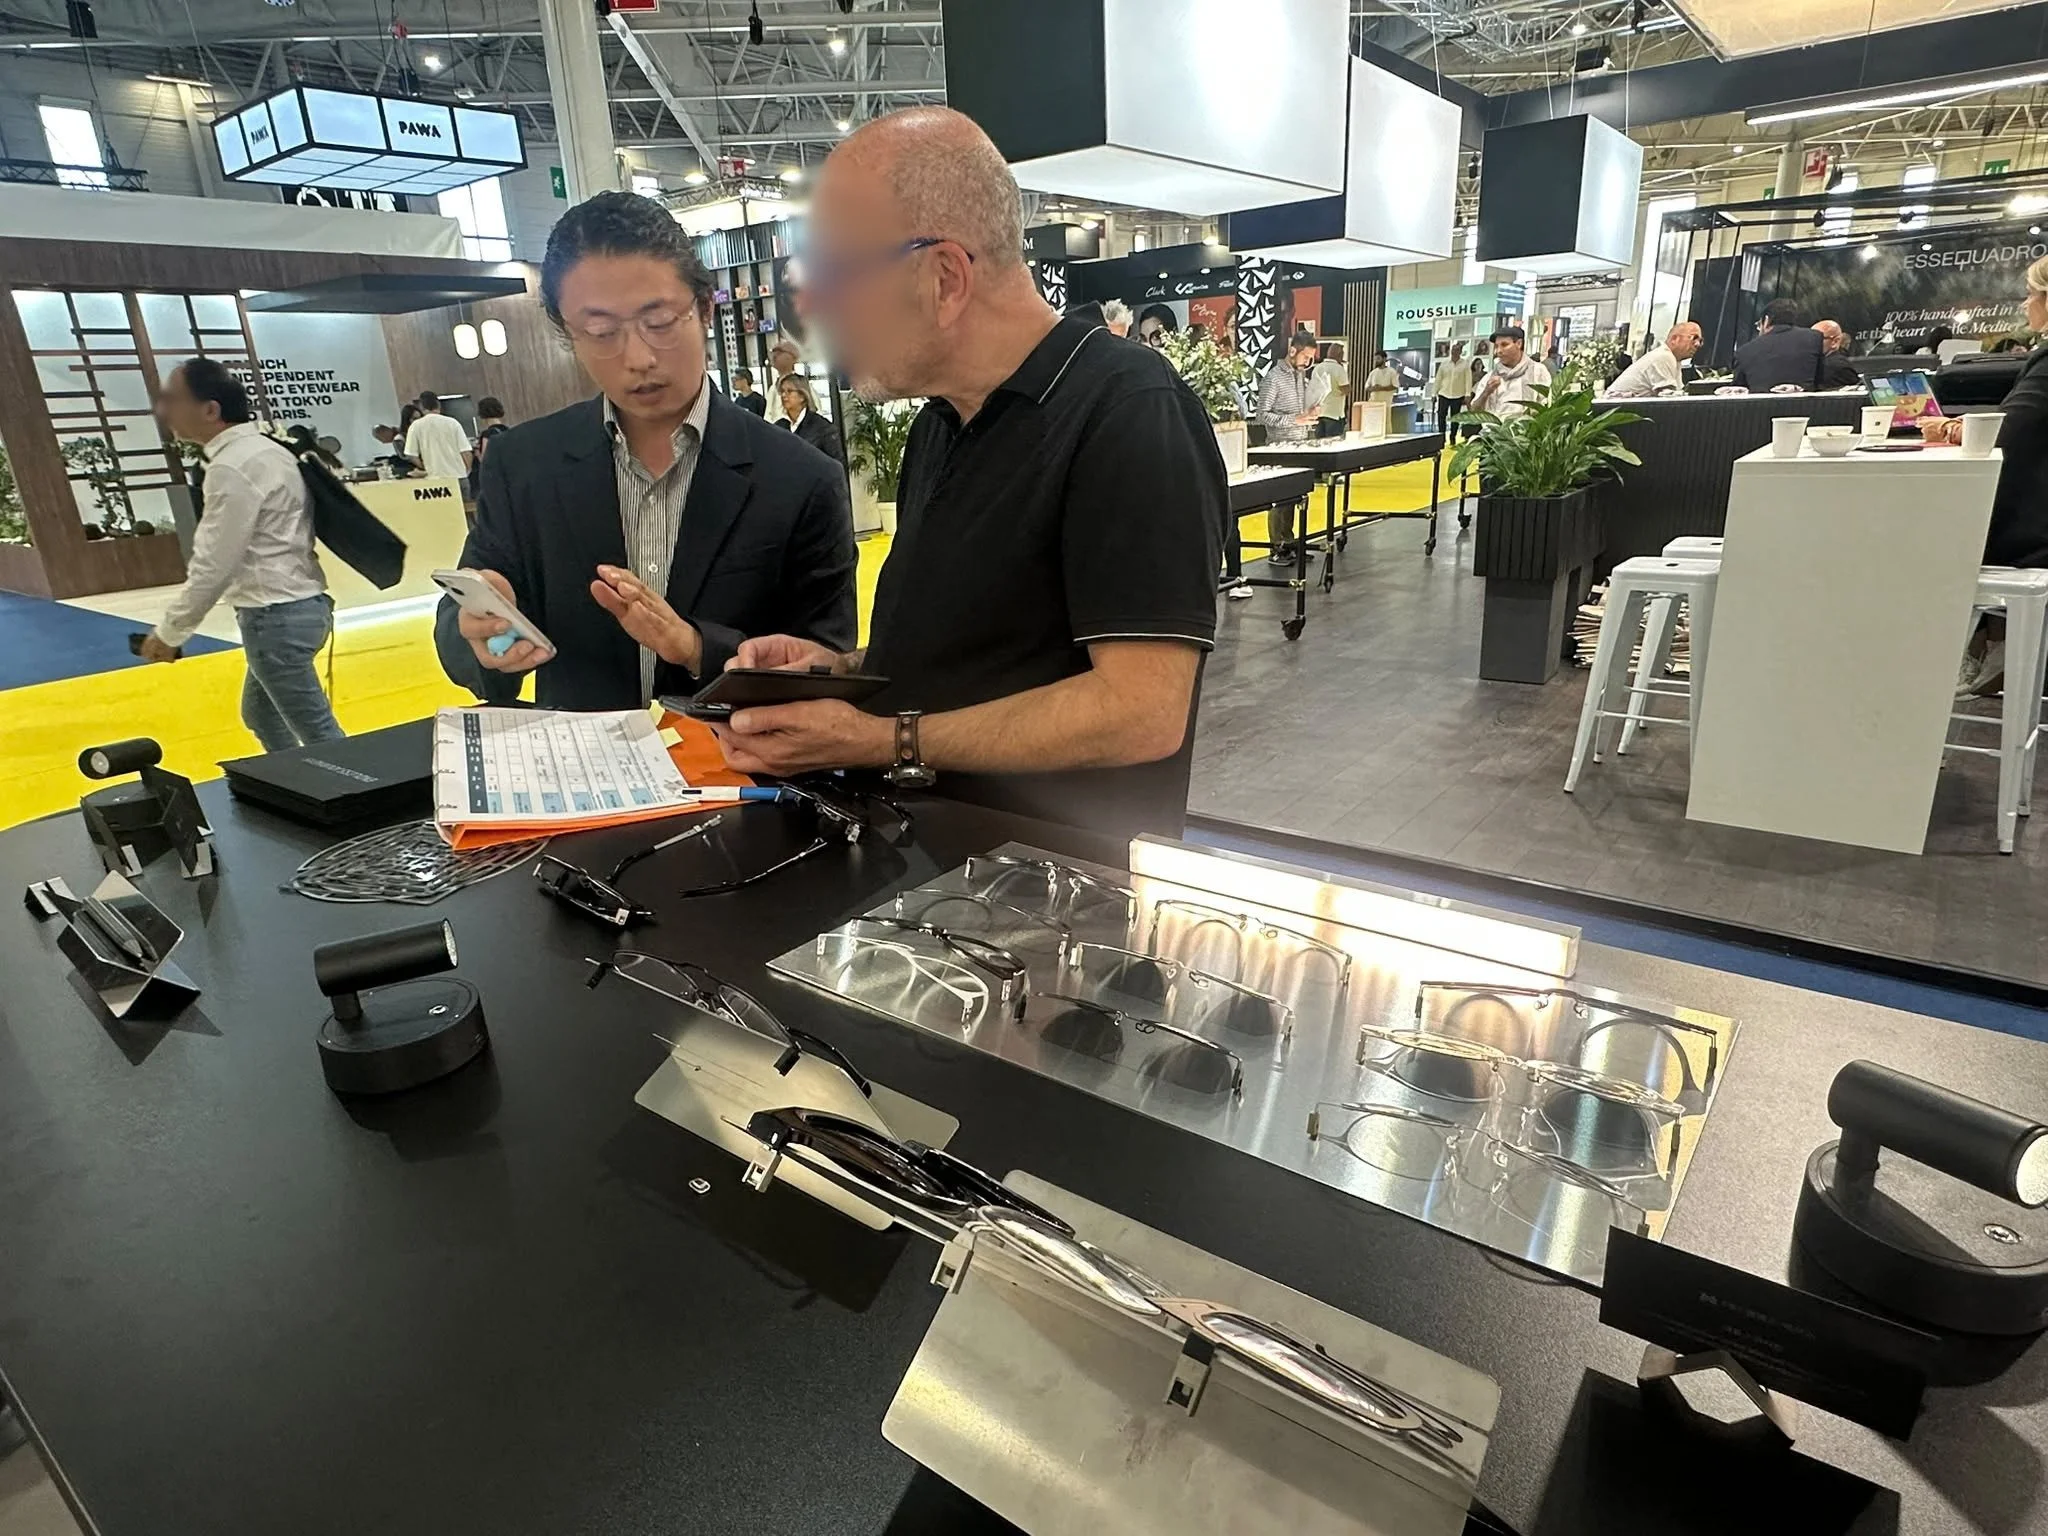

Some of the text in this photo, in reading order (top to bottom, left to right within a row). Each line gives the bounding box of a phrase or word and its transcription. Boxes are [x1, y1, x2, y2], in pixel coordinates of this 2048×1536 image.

[251, 125, 270, 145] PAWA
[398, 120, 442, 139] PAWA
[1903, 243, 2048, 271] ESSEQUADRO
[1396, 303, 1478, 320] ROUSSILHE
[1884, 309, 1917, 323] 100%
[1855, 330, 1868, 340] at
[1892, 325, 1927, 338] heart
[1969, 319, 2021, 334] Mediter
[287, 382, 361, 395] EYEWEAR
[281, 395, 333, 408] TOKYO
[272, 408, 312, 420] ARIS.
[413, 486, 453, 501] PAWA
